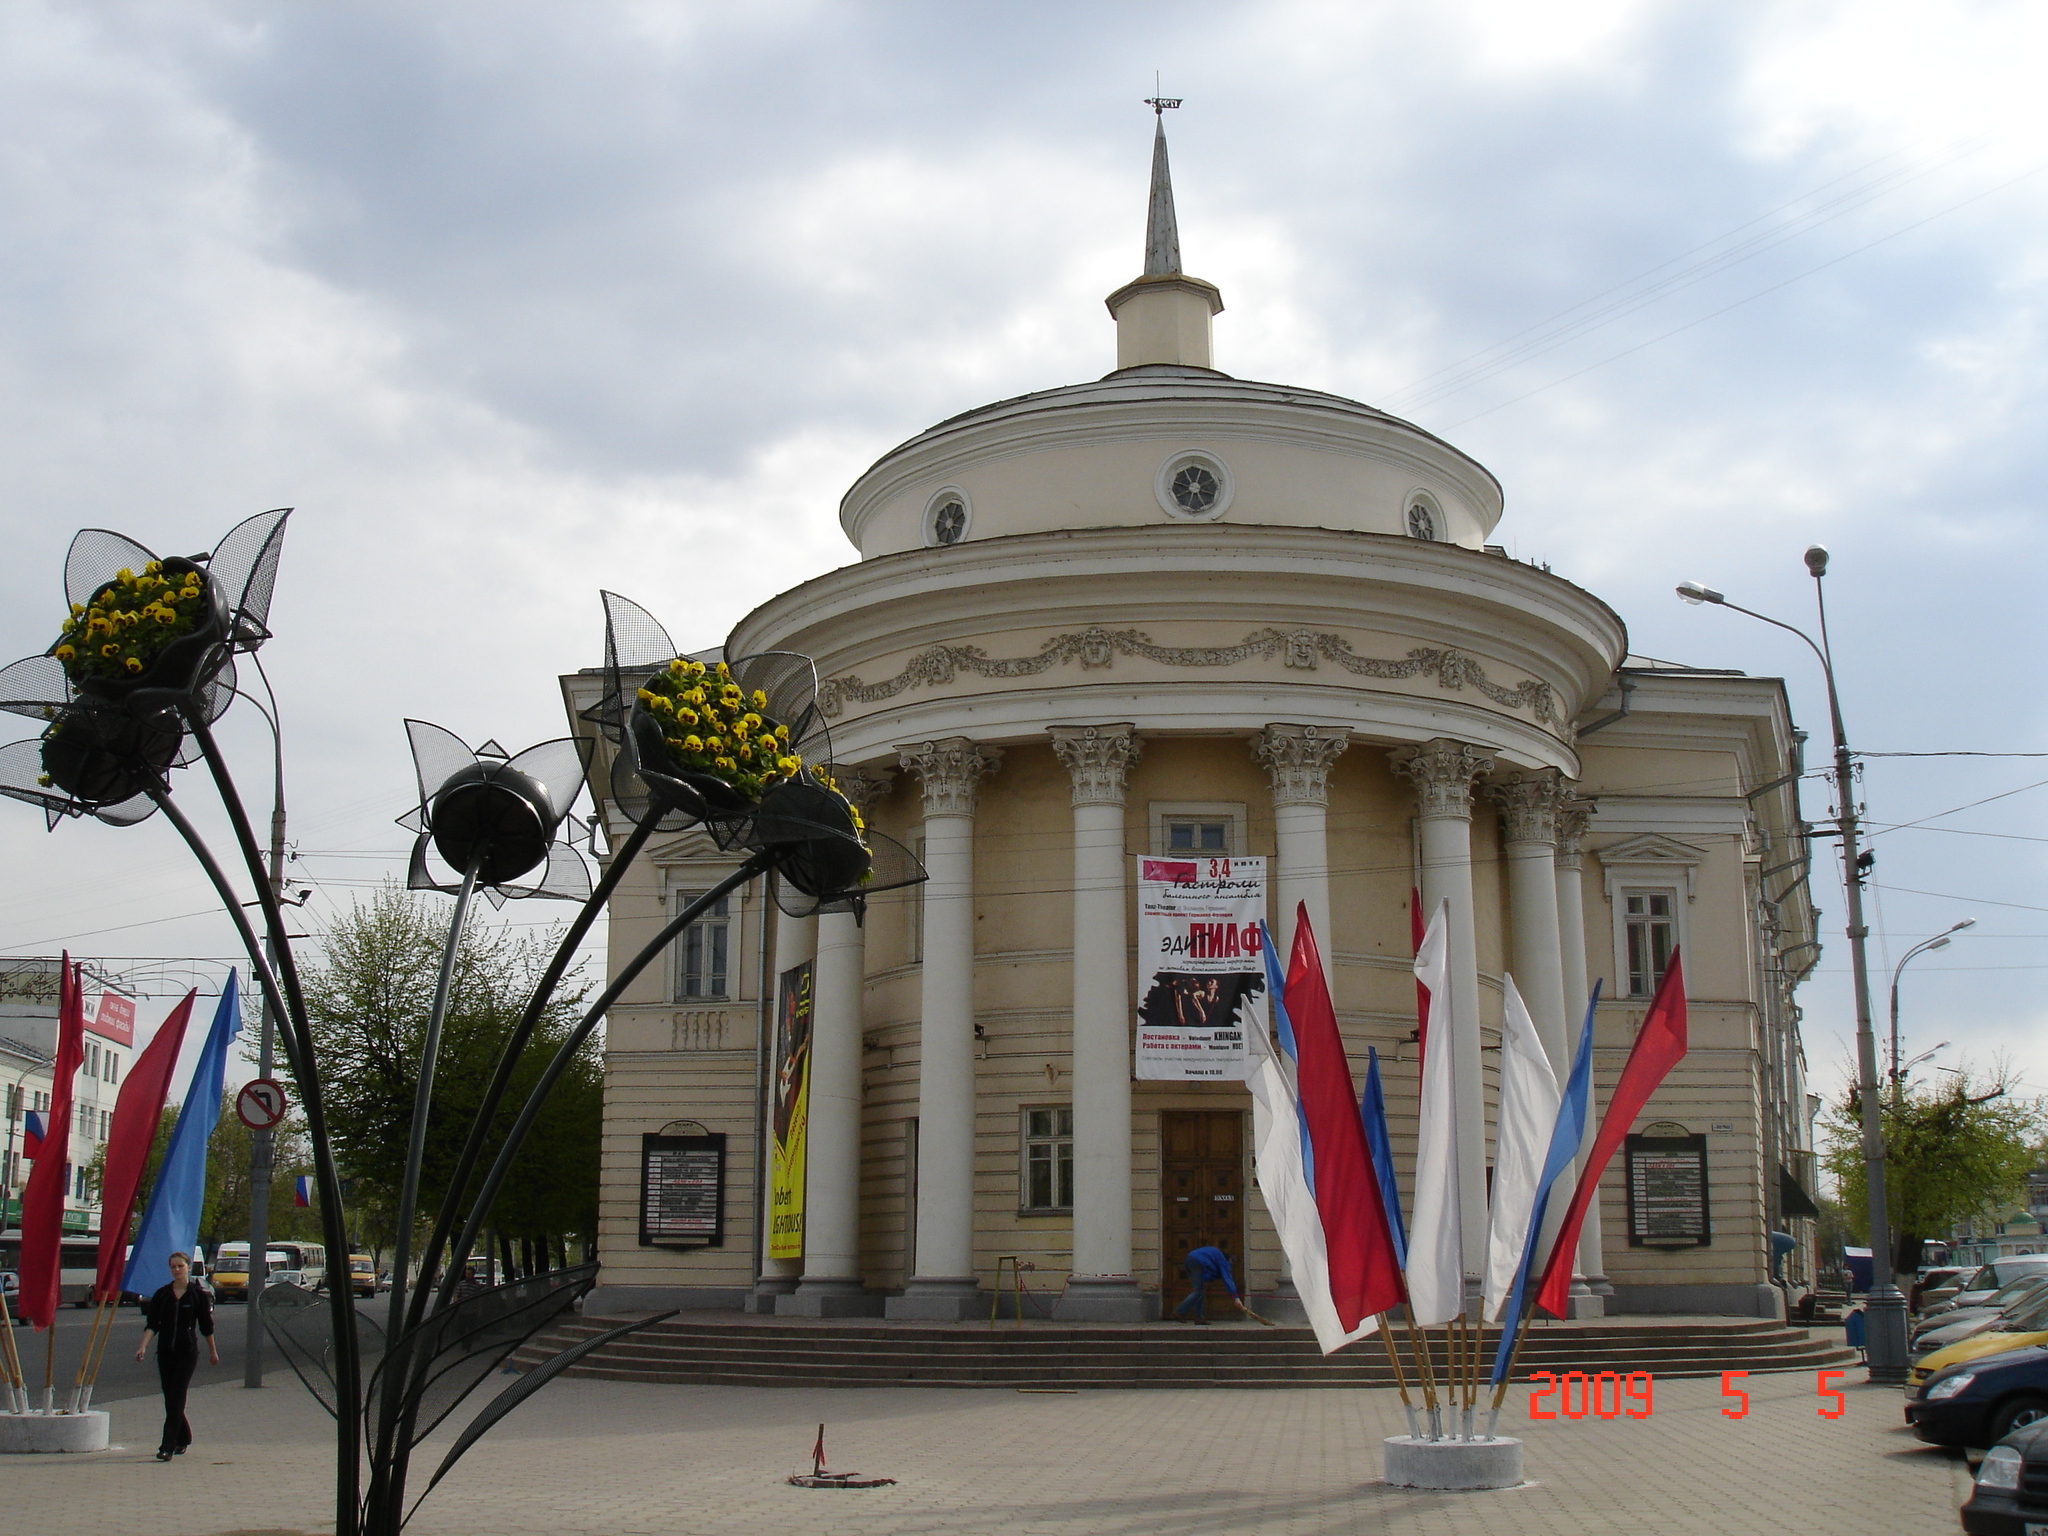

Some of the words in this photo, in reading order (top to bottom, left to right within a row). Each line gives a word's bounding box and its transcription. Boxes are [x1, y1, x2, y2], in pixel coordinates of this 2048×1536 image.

[1209, 858, 1231, 880] 3,4
[1173, 872, 1261, 894] Гастроли
[1162, 889, 1211, 900] балетного
[1190, 922, 1263, 958] ПИАФ
